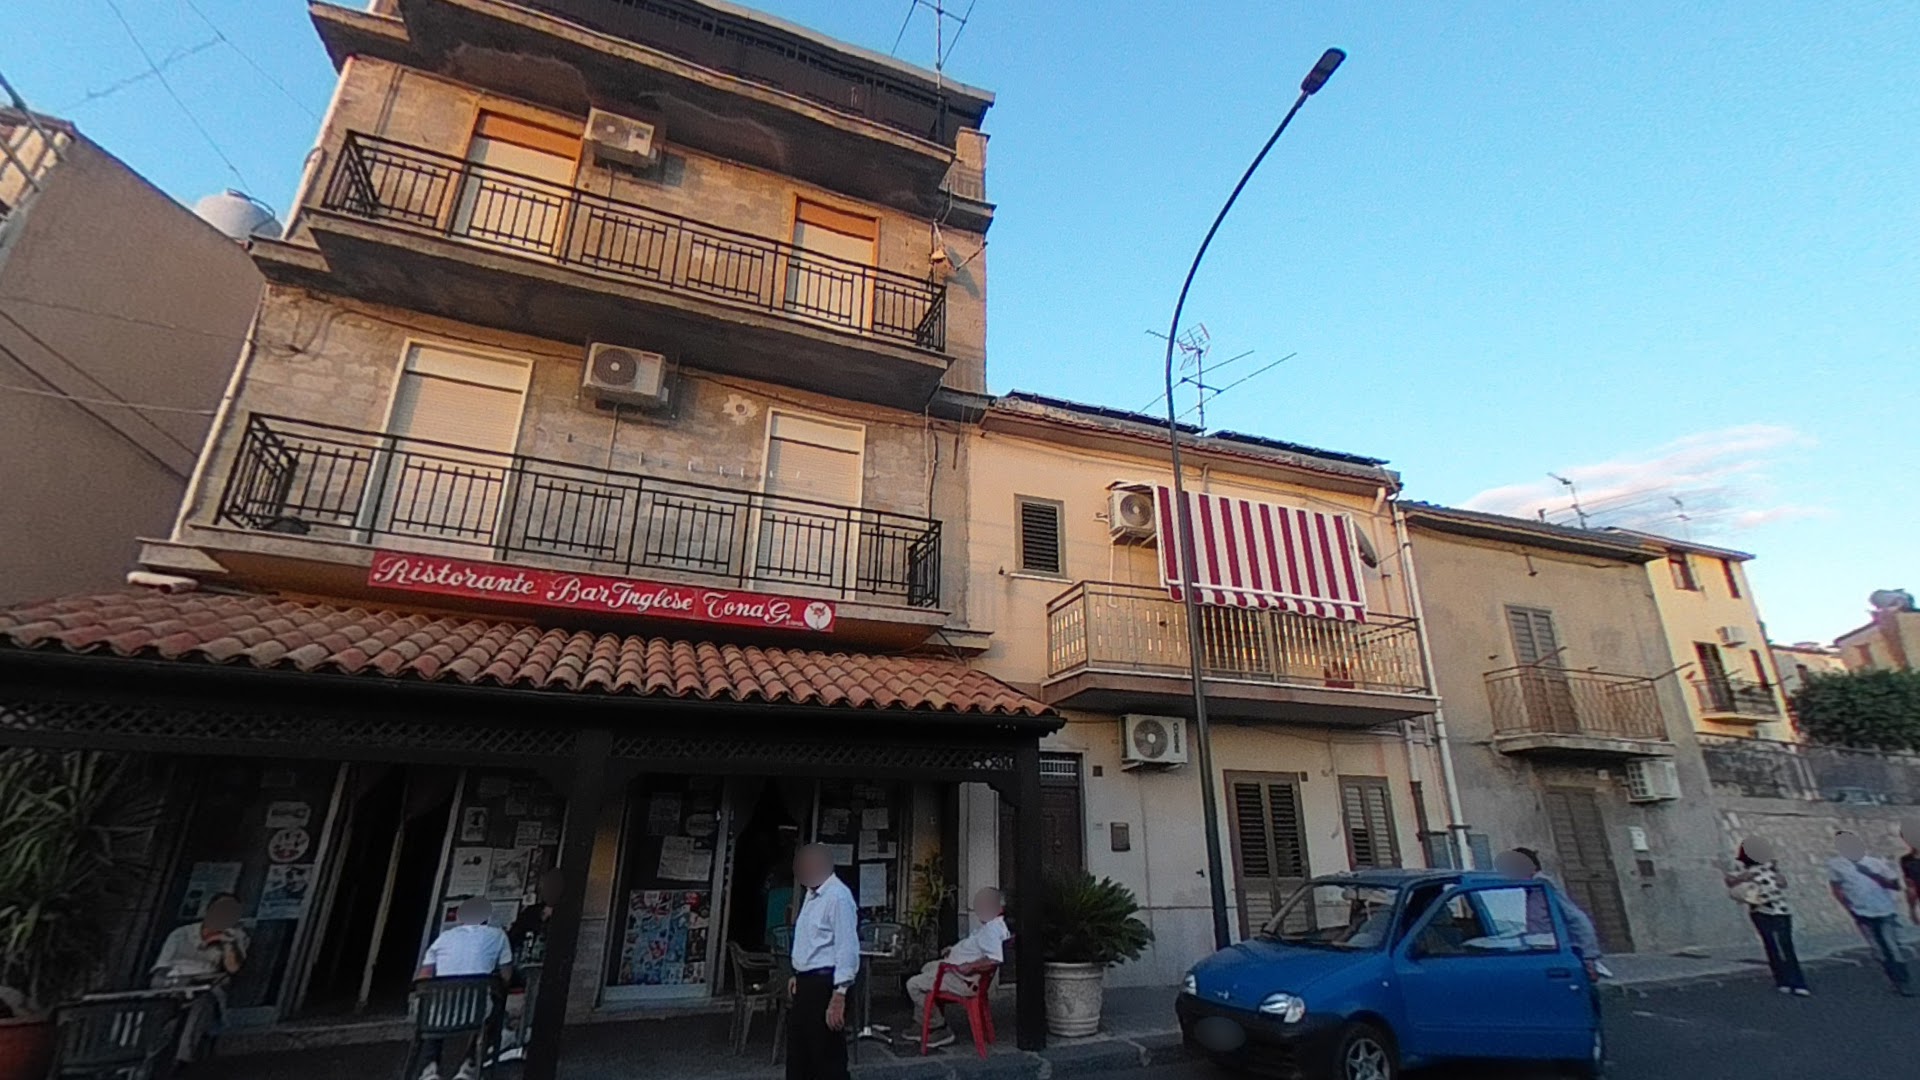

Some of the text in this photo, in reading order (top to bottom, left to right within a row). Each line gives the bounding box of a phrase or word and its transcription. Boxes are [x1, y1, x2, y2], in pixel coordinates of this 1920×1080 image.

[374, 557, 538, 594] Ristorante
[546, 575, 610, 603] Bar
[608, 582, 693, 612] Inglese
[703, 592, 765, 618] Tona
